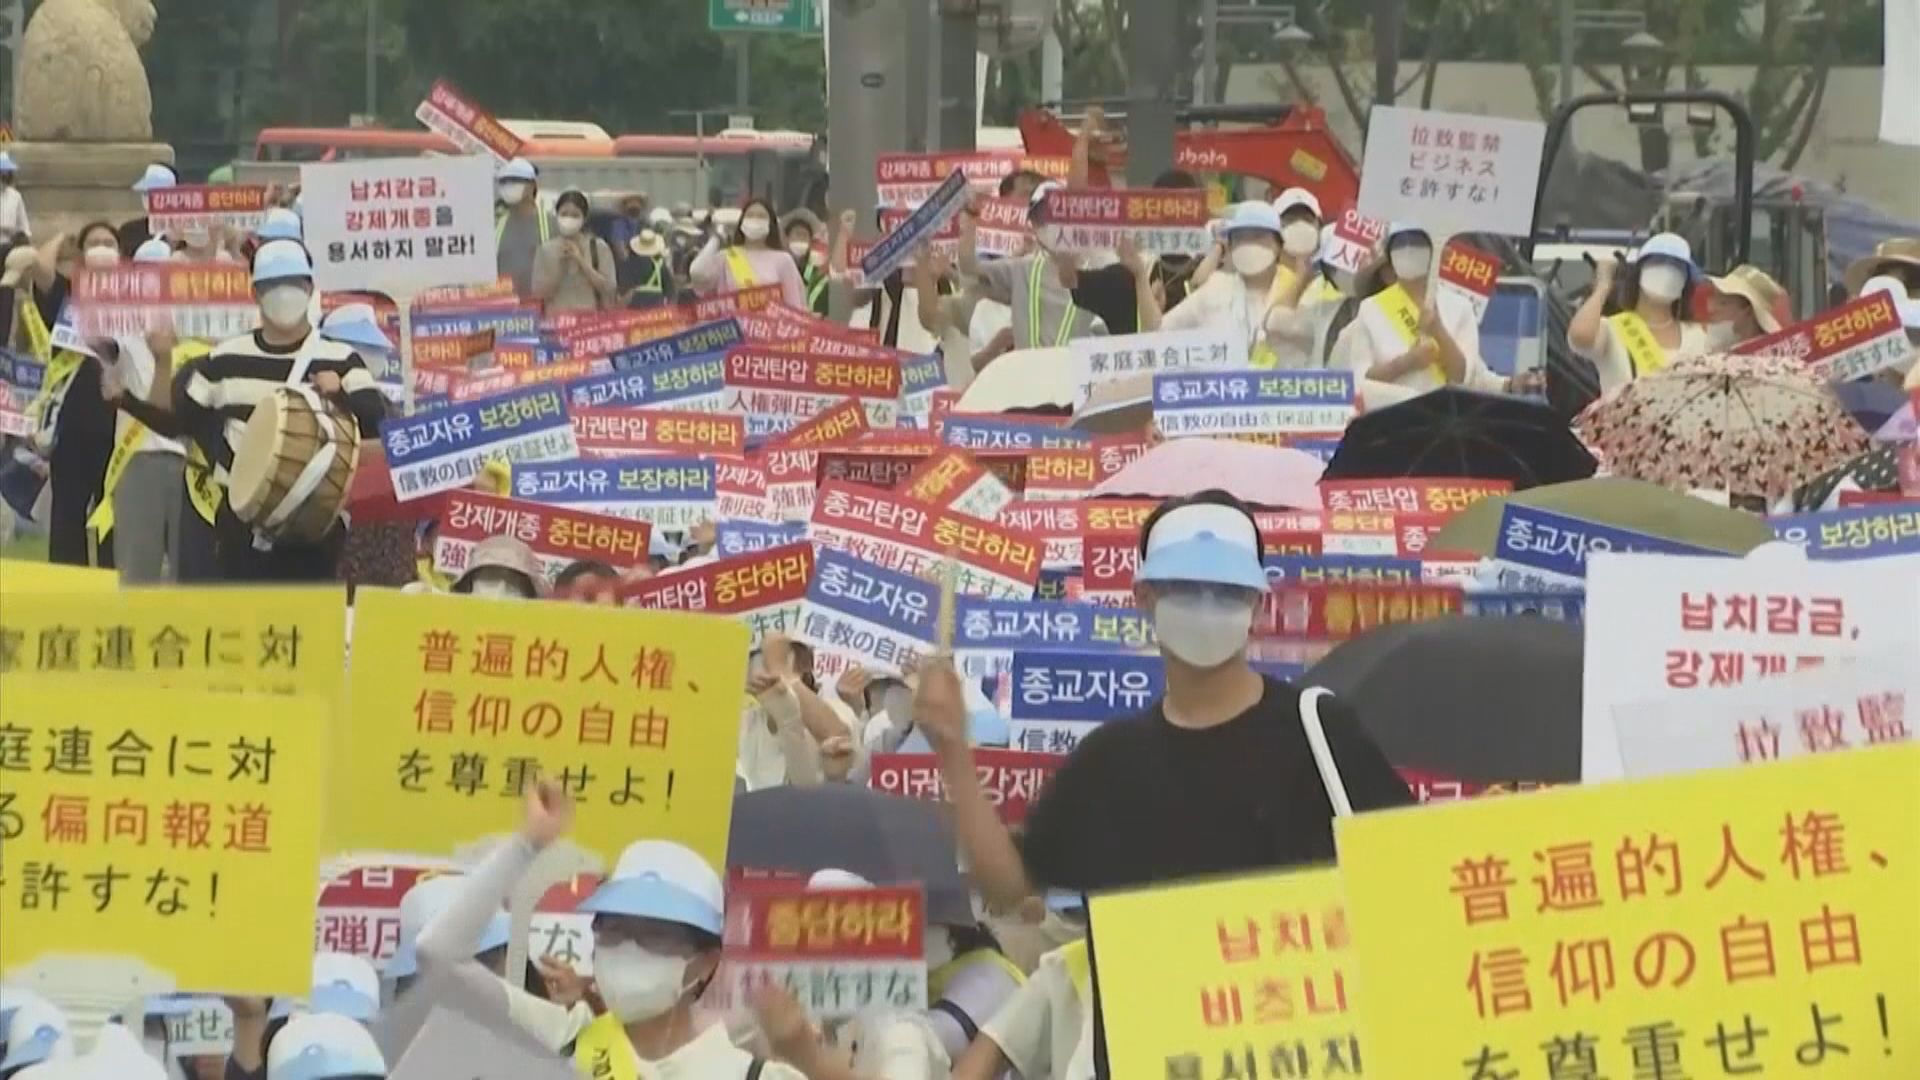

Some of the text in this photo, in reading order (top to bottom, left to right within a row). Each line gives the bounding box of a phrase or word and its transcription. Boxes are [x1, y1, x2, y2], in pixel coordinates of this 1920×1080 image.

[1409, 154, 1496, 177] ビジネス
[350, 176, 446, 201] 납치감금,
[1400, 177, 1500, 203] を許すな!
[345, 205, 453, 232] 강제개종을
[328, 234, 476, 264] 용서하지 말라!
[1814, 298, 1894, 349] 중단하라
[413, 340, 462, 361] 단하라
[652, 359, 725, 392] 보장하라
[731, 354, 895, 391] 인권탄압 중단하라
[1158, 377, 1348, 403] 종교자유 보장하라
[387, 391, 562, 457] 종교자유 보장하라
[655, 418, 738, 447] 중단하라
[792, 405, 861, 446] 단하라
[517, 467, 711, 496] 종교자유 보장하라
[1029, 455, 1095, 482] 단하라
[1328, 486, 1420, 513] 종교탄압
[448, 500, 644, 559] 강제개종 중단하라
[823, 489, 928, 536] 종교탄압
[933, 515, 1037, 574] 중단하라
[1000, 507, 1080, 532] 제개종
[440, 542, 468, 567] 強
[721, 531, 802, 555] 종교자
[629, 552, 809, 610] 교탄압 중단하라
[819, 561, 929, 626] 종교자유
[962, 608, 1154, 643] 종교자유 보장
[1680, 591, 1861, 642] 납치감금,
[418, 628, 701, 694] 普遍的人権、
[1664, 649, 1826, 689] 강제개
[1019, 667, 1153, 709] 종교자유
[412, 687, 671, 752] 信仰の自由
[397, 746, 677, 813] を尊重せよ!
[976, 765, 1045, 806] 강제
[1448, 808, 1890, 926] 普遍的人権、
[19, 860, 220, 919] 許すな!
[1465, 903, 1863, 1020] 信仰の自由
